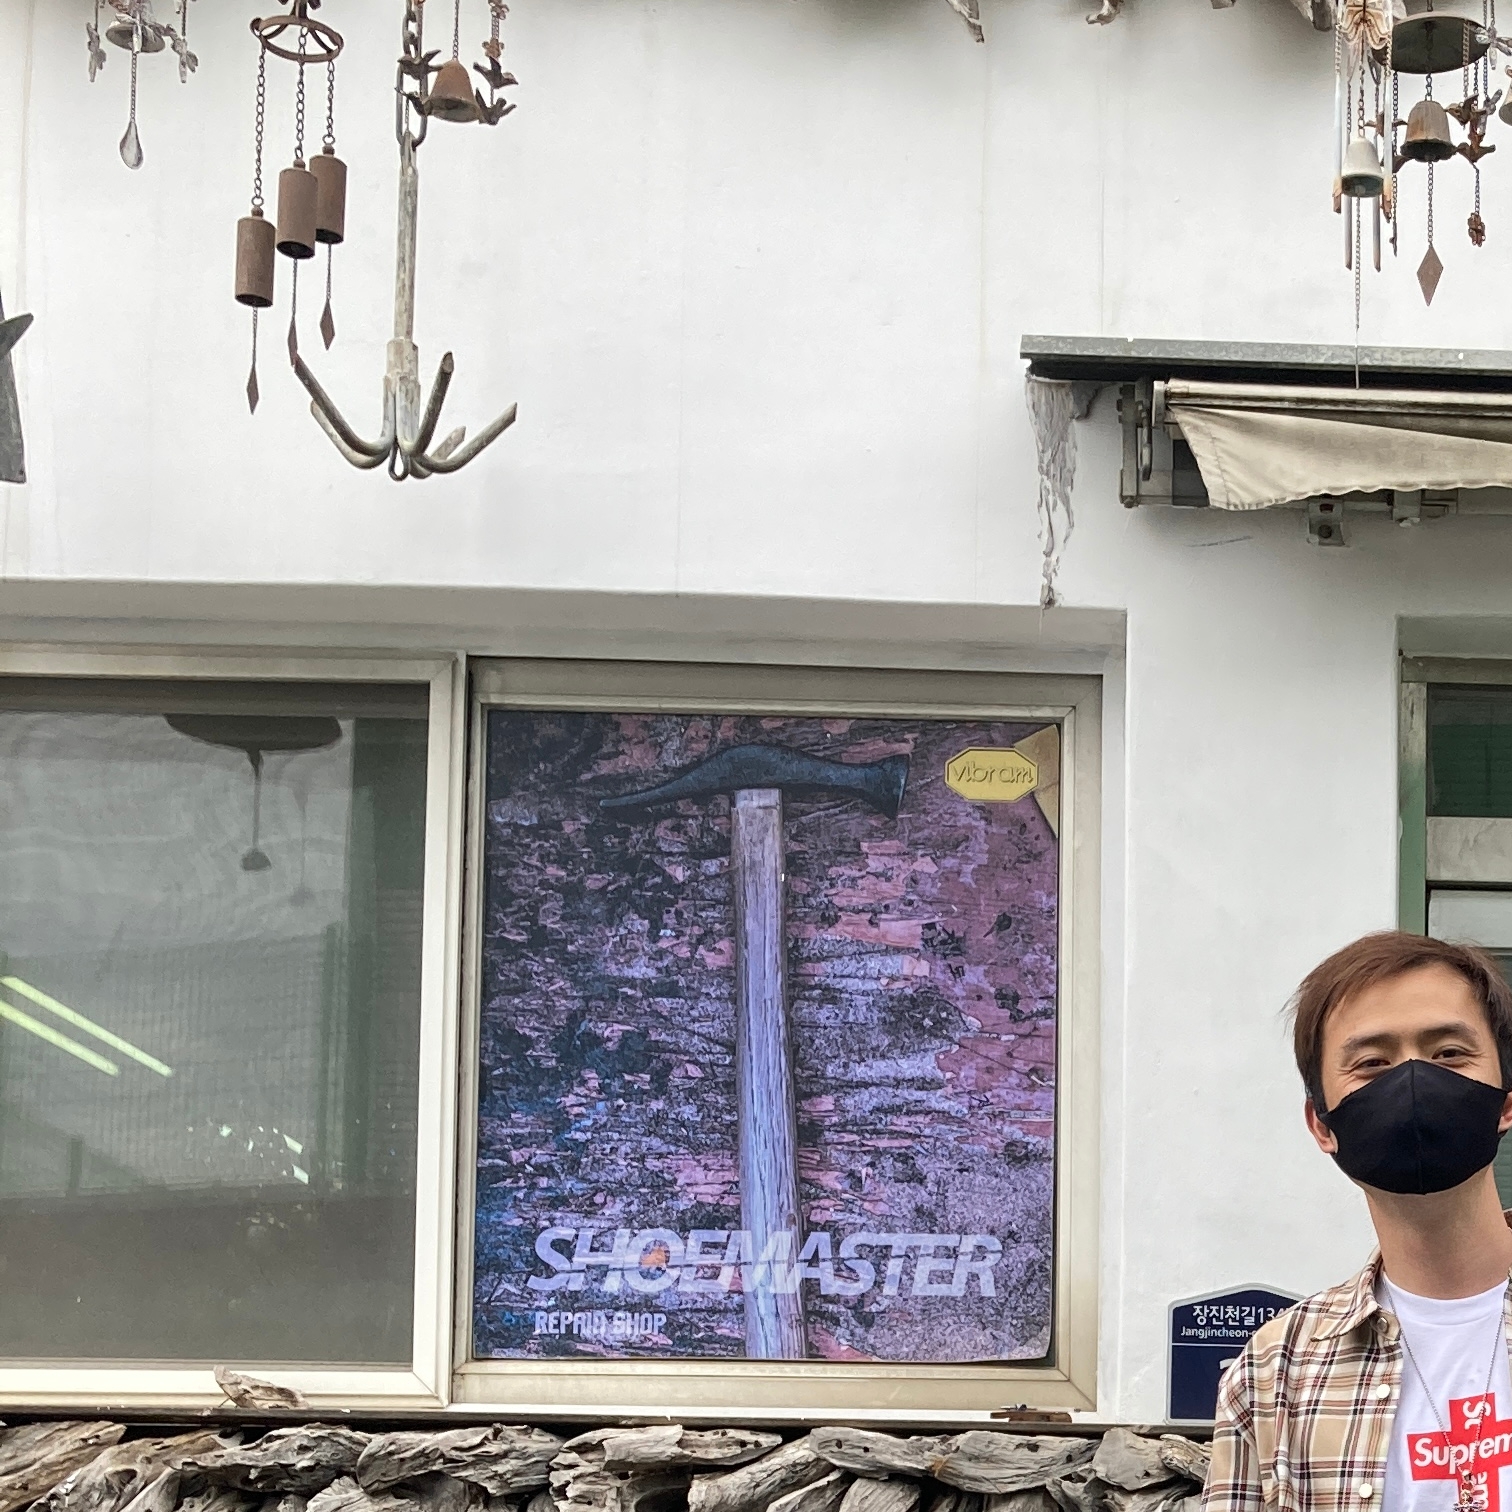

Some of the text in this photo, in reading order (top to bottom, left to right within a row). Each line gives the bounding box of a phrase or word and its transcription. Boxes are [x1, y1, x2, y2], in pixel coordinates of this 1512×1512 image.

[953, 760, 1034, 784] vibram
[528, 1227, 1002, 1298] SHOEMASTER
[612, 1310, 667, 1336] SHOP
